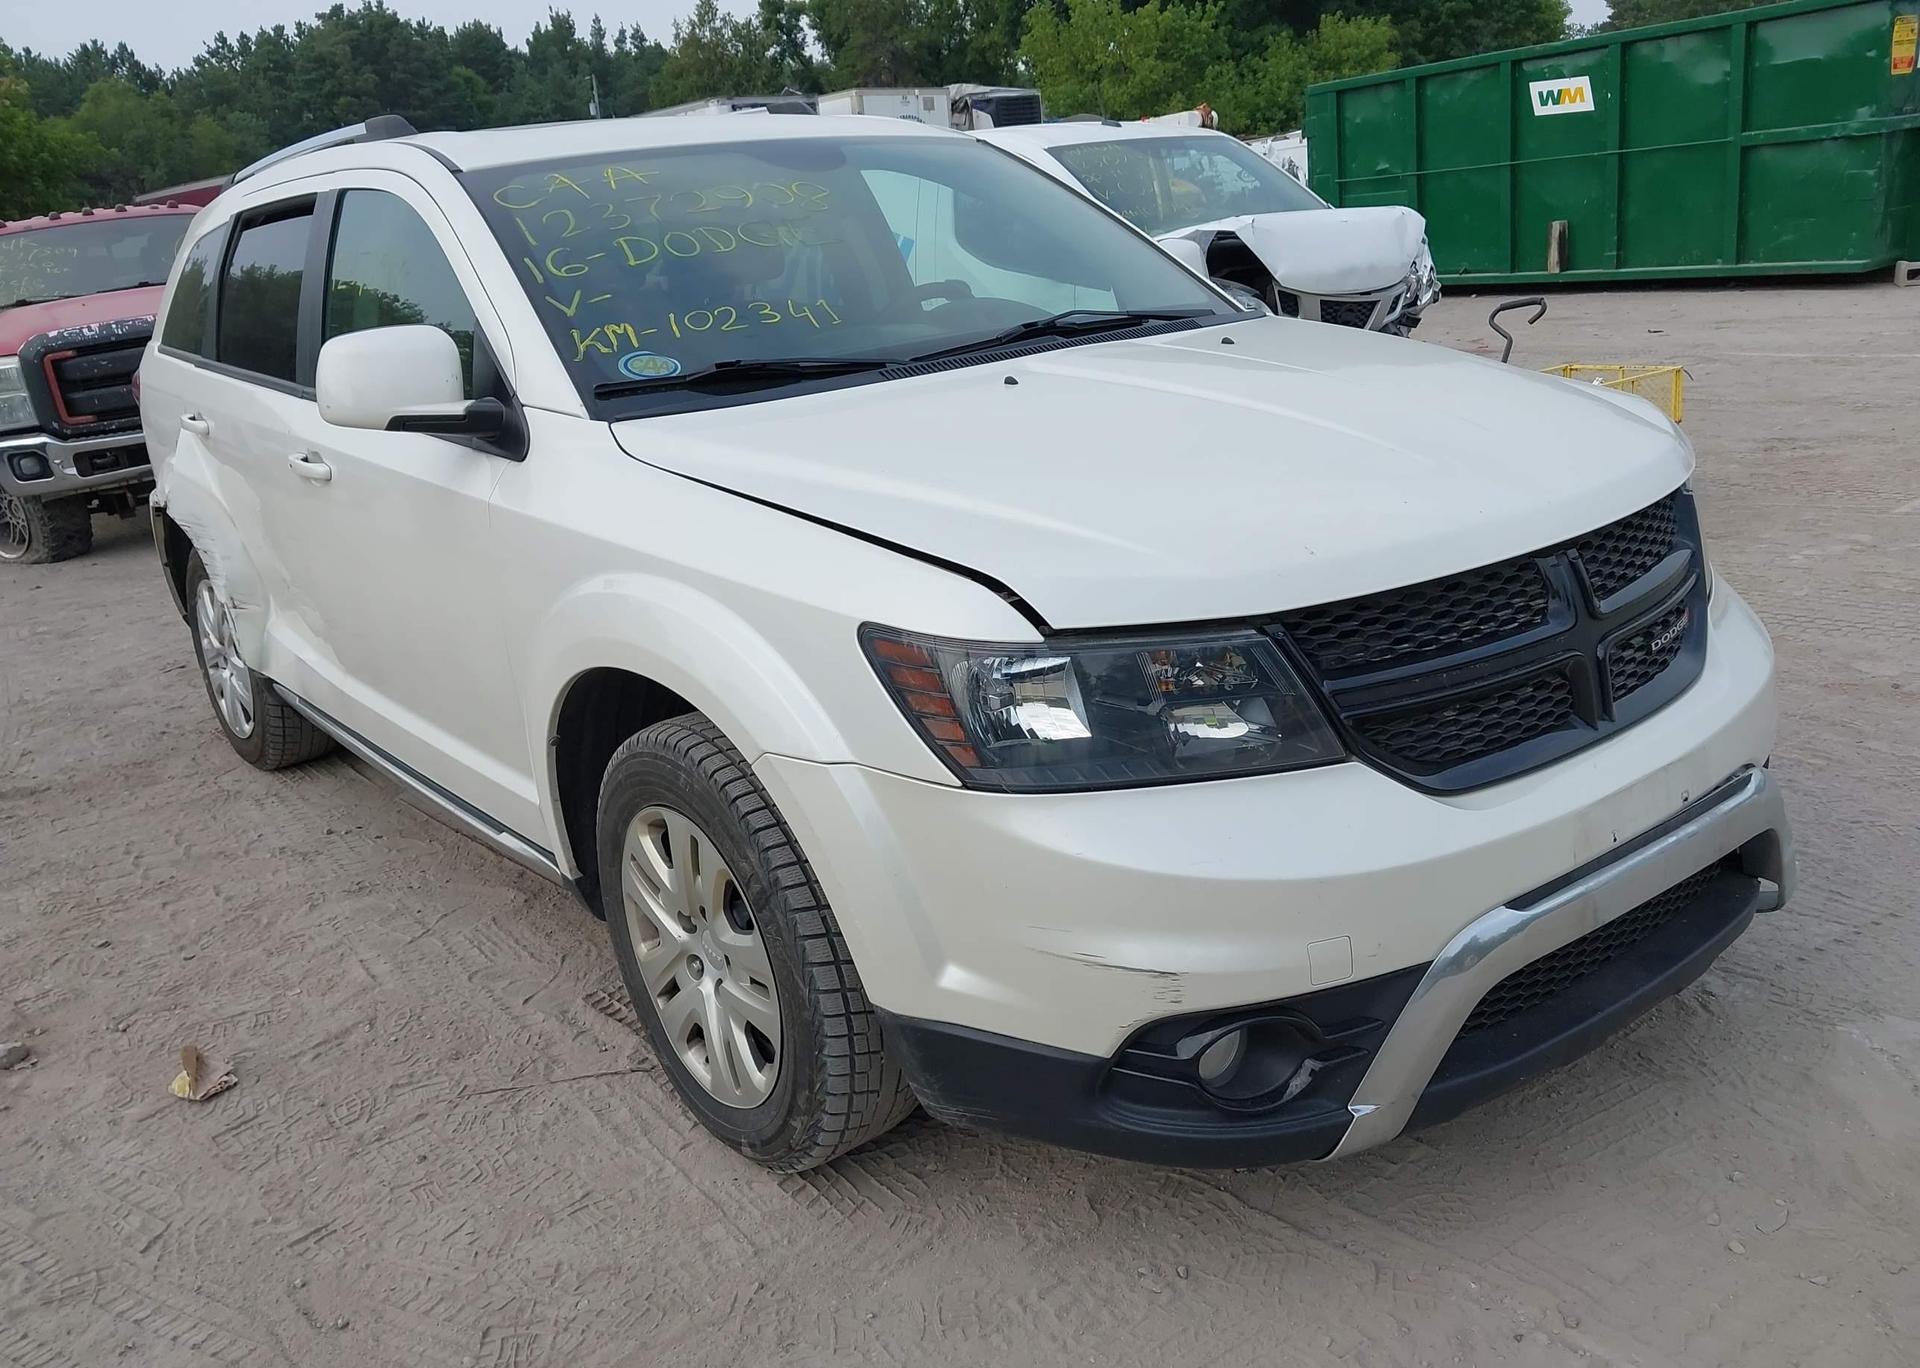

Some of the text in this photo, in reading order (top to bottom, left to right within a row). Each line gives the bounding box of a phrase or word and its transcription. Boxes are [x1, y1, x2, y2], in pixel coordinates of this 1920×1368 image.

[1537, 86, 1586, 107] WM
[570, 299, 843, 362] KM-102341
[1651, 615, 1689, 651] DODGE
